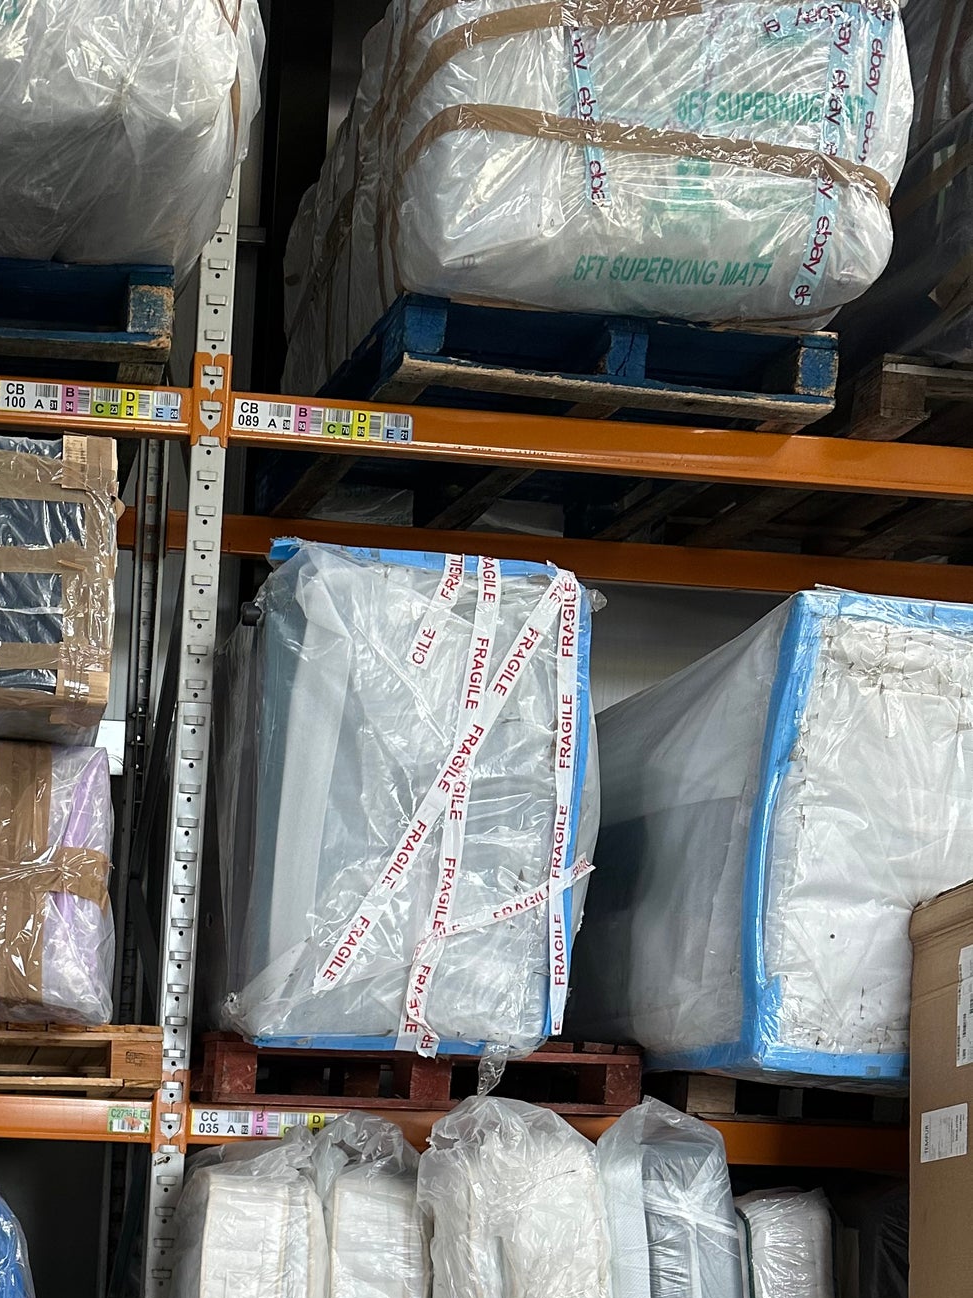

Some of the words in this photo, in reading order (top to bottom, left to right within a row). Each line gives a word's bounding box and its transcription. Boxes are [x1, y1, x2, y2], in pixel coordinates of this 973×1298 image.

[866, 38, 886, 95] ebay
[803, 215, 833, 276] ebay
[573, 255, 609, 281] 6FT
[609, 256, 719, 286] SUPERKING
[719, 262, 774, 287] MATT
[6, 383, 25, 395] CB
[66, 387, 75, 397] B
[127, 392, 135, 401] D
[4, 396, 25, 409] 100
[34, 399, 44, 409] A
[95, 403, 104, 413] C
[240, 401, 259, 414] CB
[299, 408, 307, 417] B
[238, 415, 259, 427] 089
[268, 418, 277, 428] A
[327, 424, 336, 434] C
[358, 413, 366, 423] D
[386, 428, 395, 438] E
[562, 582, 577, 658] FRAGILE
[412, 627, 437, 665] GILE
[493, 627, 539, 697] FRAGILE
[464, 637, 490, 710] FRAGILE
[559, 694, 574, 769] FRAGILE
[437, 723, 485, 794] FRAGILE
[552, 805, 568, 879] FRAGILE
[381, 819, 427, 890] FRAGILE
[432, 857, 457, 931] FRAGILE
[493, 884, 550, 919] FRAGIL
[322, 915, 371, 982] FRAGILE
[554, 913, 566, 986] FRAGILE
[200, 1111, 218, 1122] CC
[256, 1113, 264, 1122] B
[312, 1115, 321, 1124] D
[198, 1123, 219, 1133] 035
[227, 1125, 235, 1134] A
